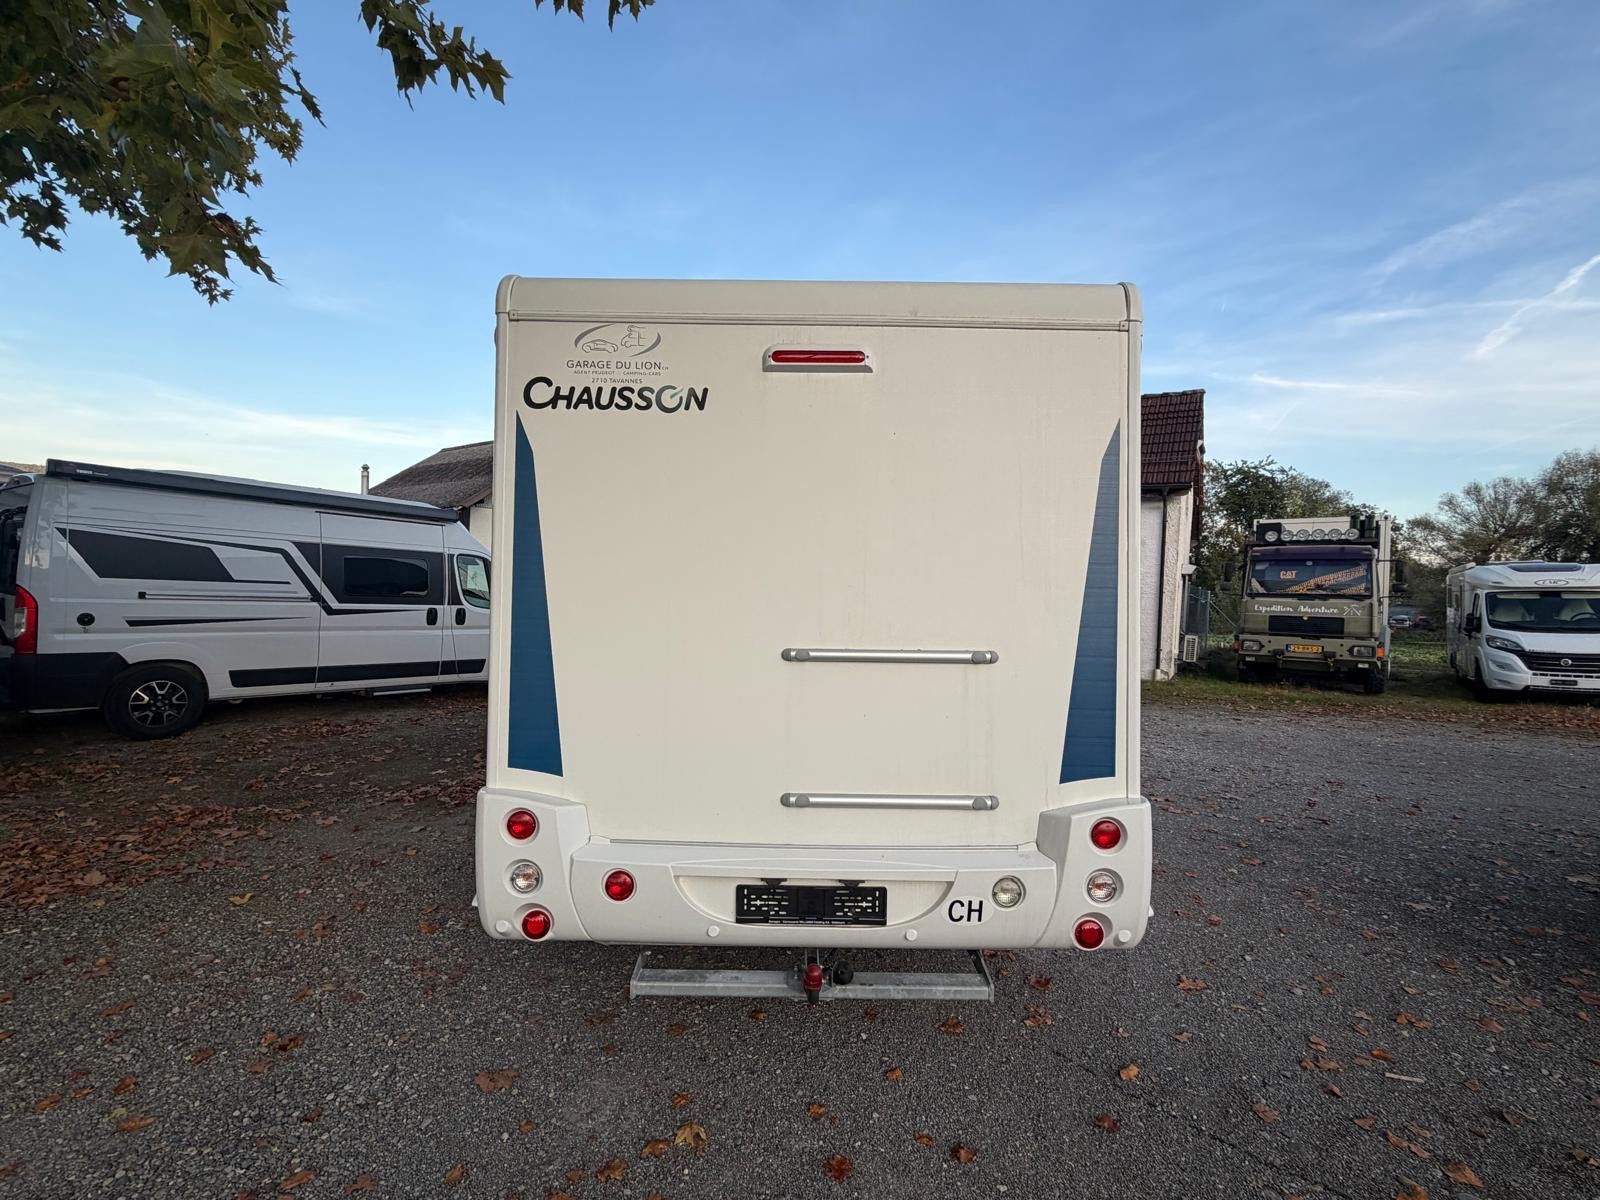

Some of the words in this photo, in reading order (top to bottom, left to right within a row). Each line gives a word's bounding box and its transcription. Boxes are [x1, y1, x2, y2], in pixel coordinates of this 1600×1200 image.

[566, 360, 612, 369] GARAGE
[615, 361, 631, 370] DU
[635, 361, 662, 370] LION
[1279, 570, 1297, 579] CAT
[1254, 604, 1294, 613] Expedition
[1297, 605, 1339, 614] Adventure
[948, 899, 983, 922] CH
